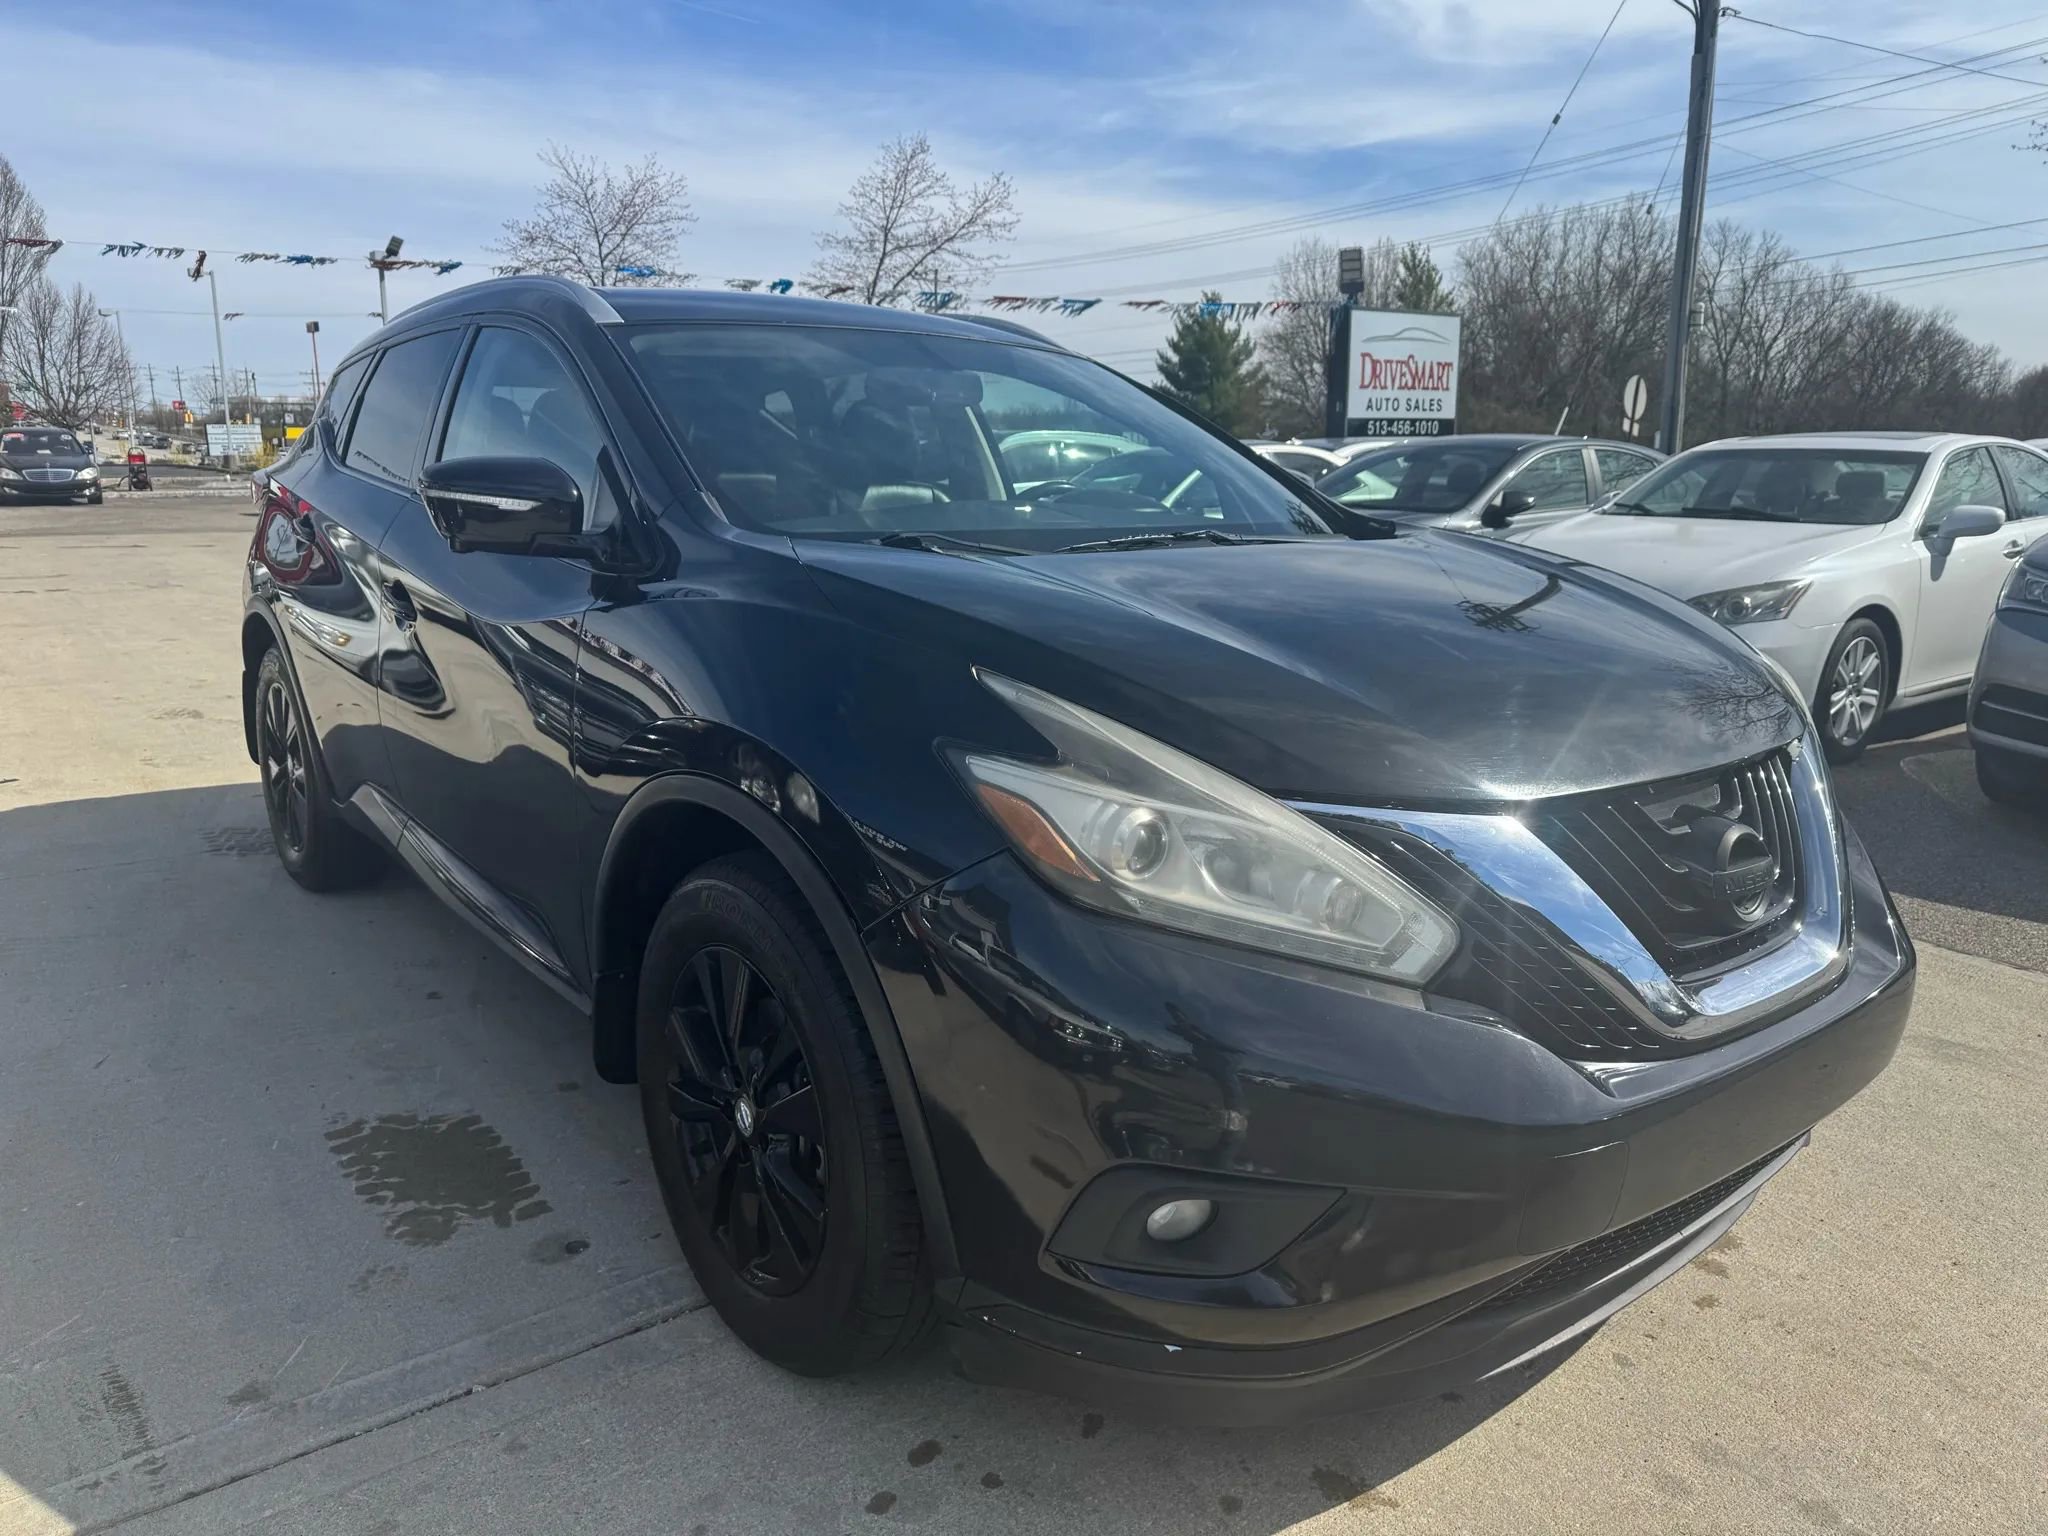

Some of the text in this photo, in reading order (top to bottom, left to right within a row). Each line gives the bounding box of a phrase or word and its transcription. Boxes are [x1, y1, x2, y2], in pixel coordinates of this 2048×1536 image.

[1366, 397, 1443, 412] AUTO SALES
[1367, 420, 1439, 435] 513-456-1010
